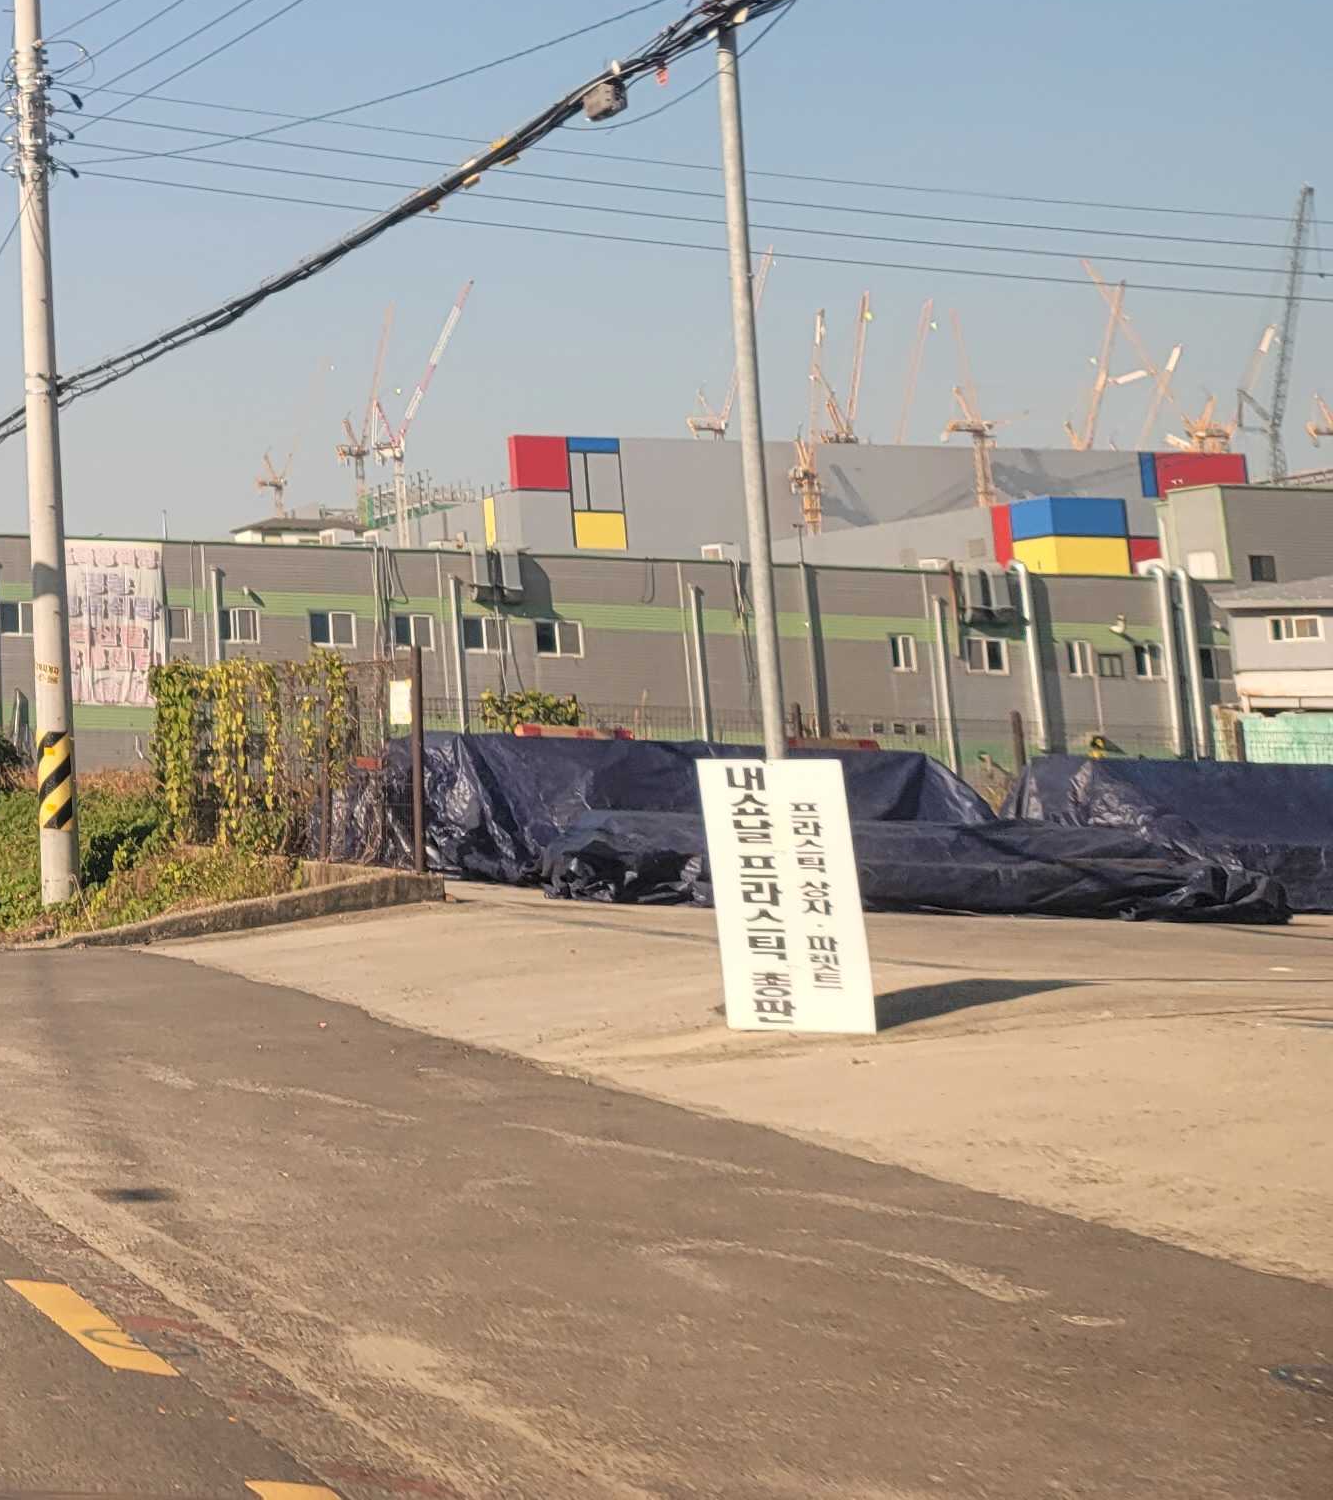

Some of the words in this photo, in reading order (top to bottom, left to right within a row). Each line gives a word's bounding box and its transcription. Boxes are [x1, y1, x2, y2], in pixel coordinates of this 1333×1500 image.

[724, 765, 774, 844] 내쇼날
[789, 802, 826, 874] 프라스틱
[738, 855, 788, 961] 프라스틱
[798, 880, 834, 916] 상자
[751, 971, 796, 1025] 총판
